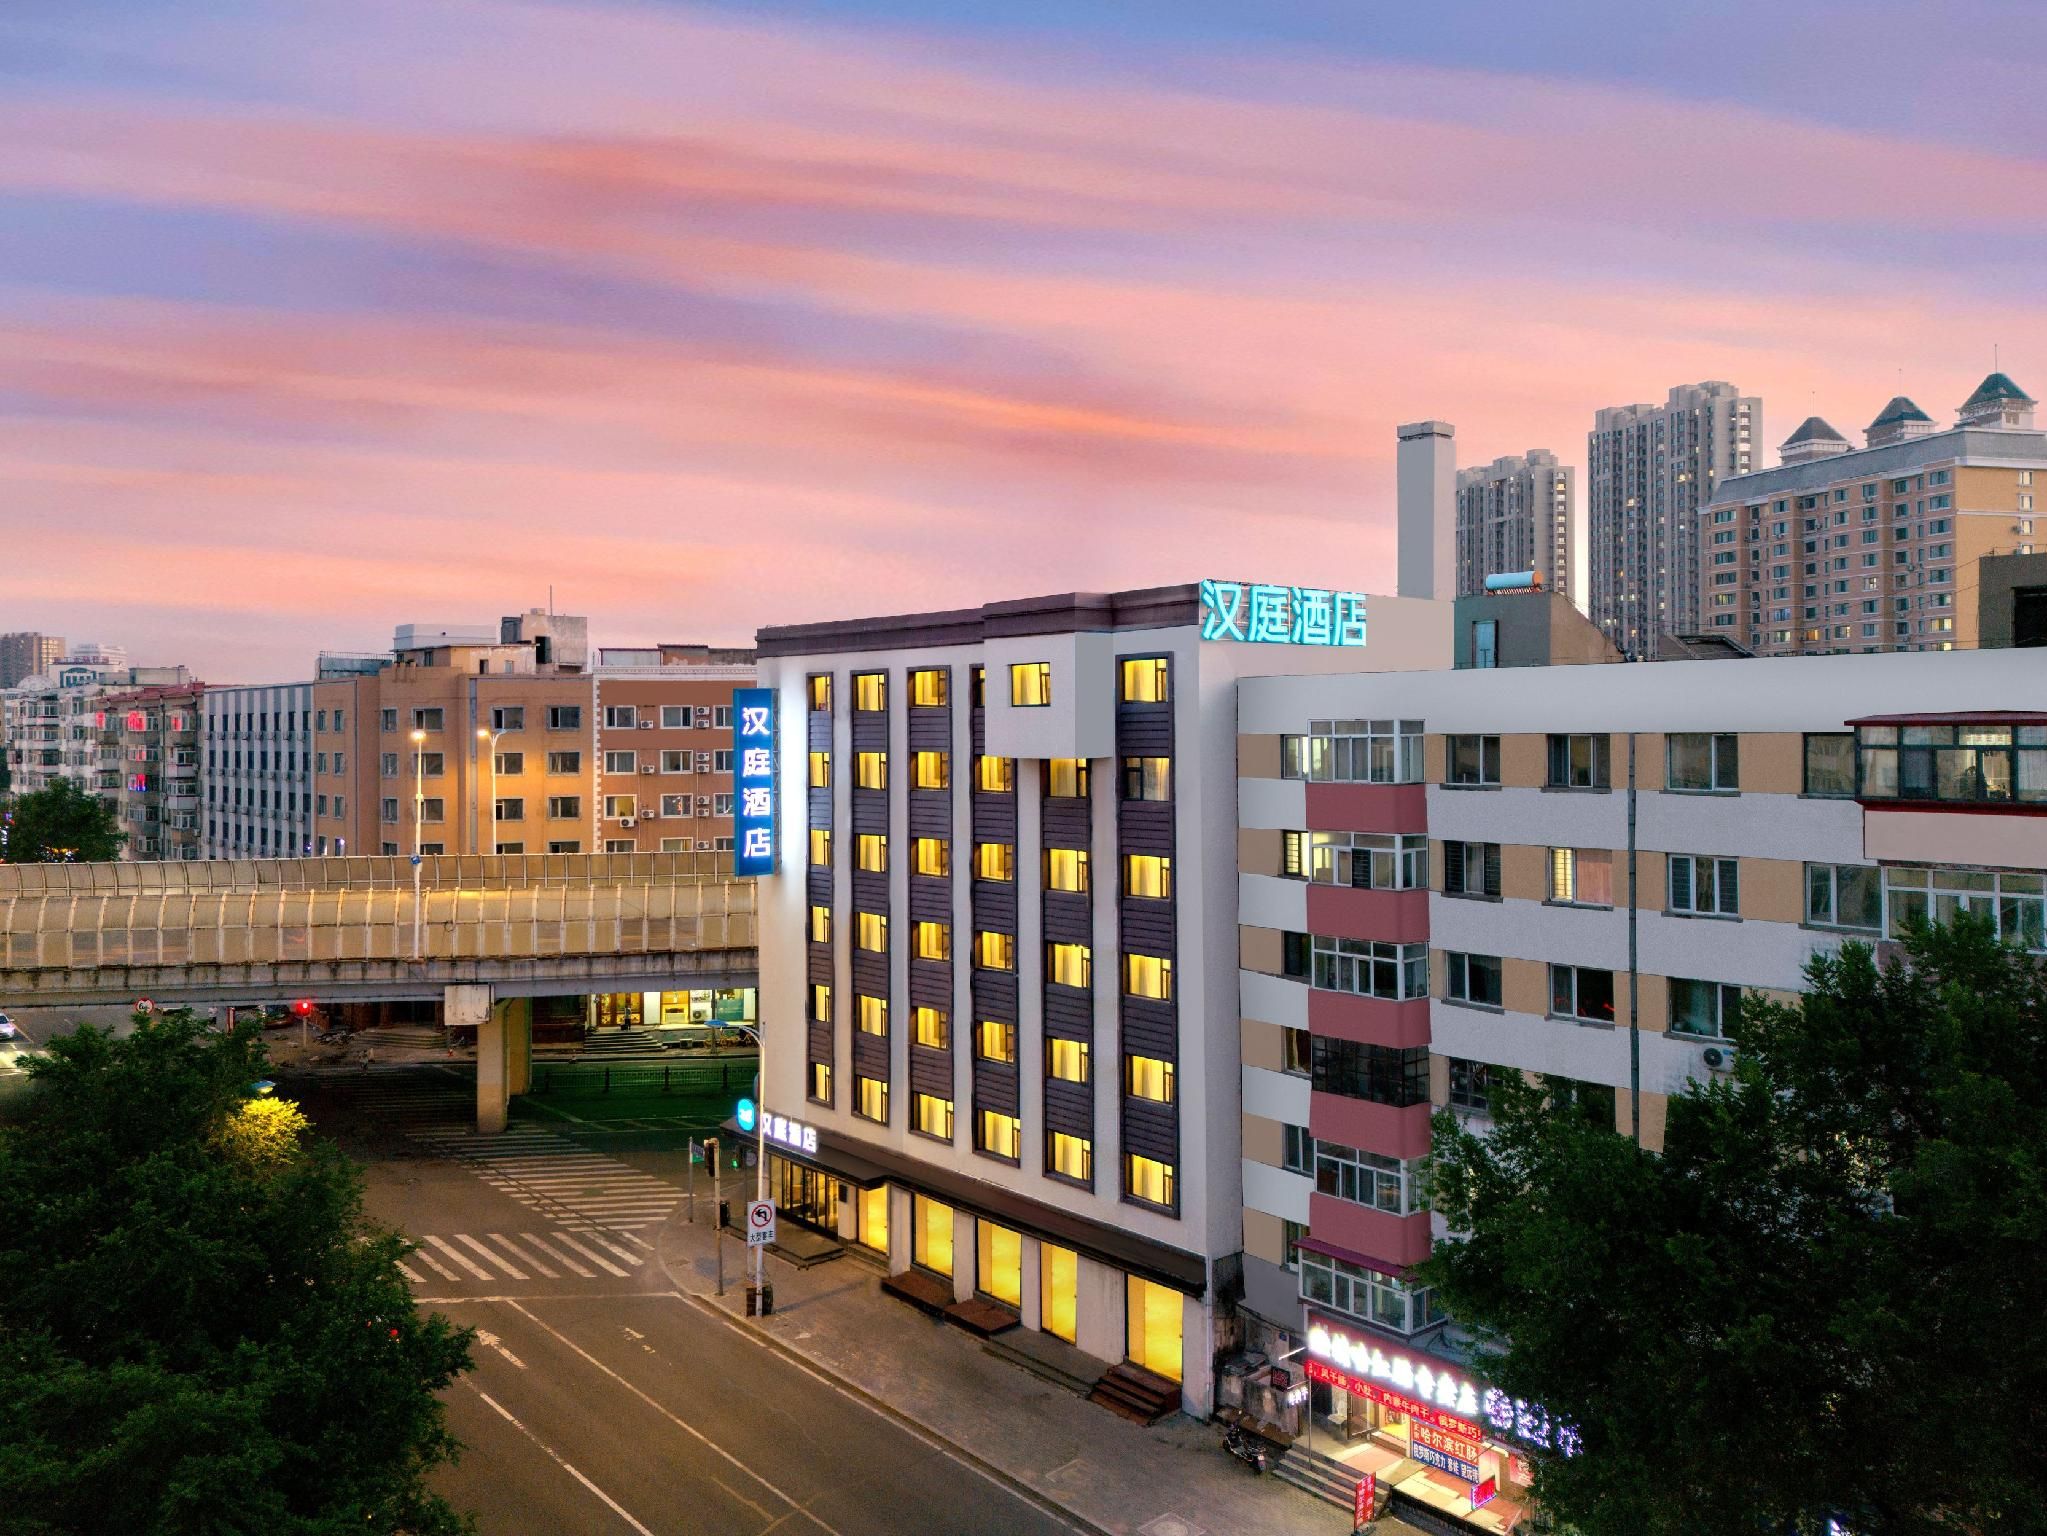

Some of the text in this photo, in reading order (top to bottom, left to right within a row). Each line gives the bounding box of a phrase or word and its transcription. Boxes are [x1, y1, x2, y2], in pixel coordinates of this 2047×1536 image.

[1201, 579, 1366, 646] 汉庭酒店
[742, 706, 771, 858] 汉庭酒店
